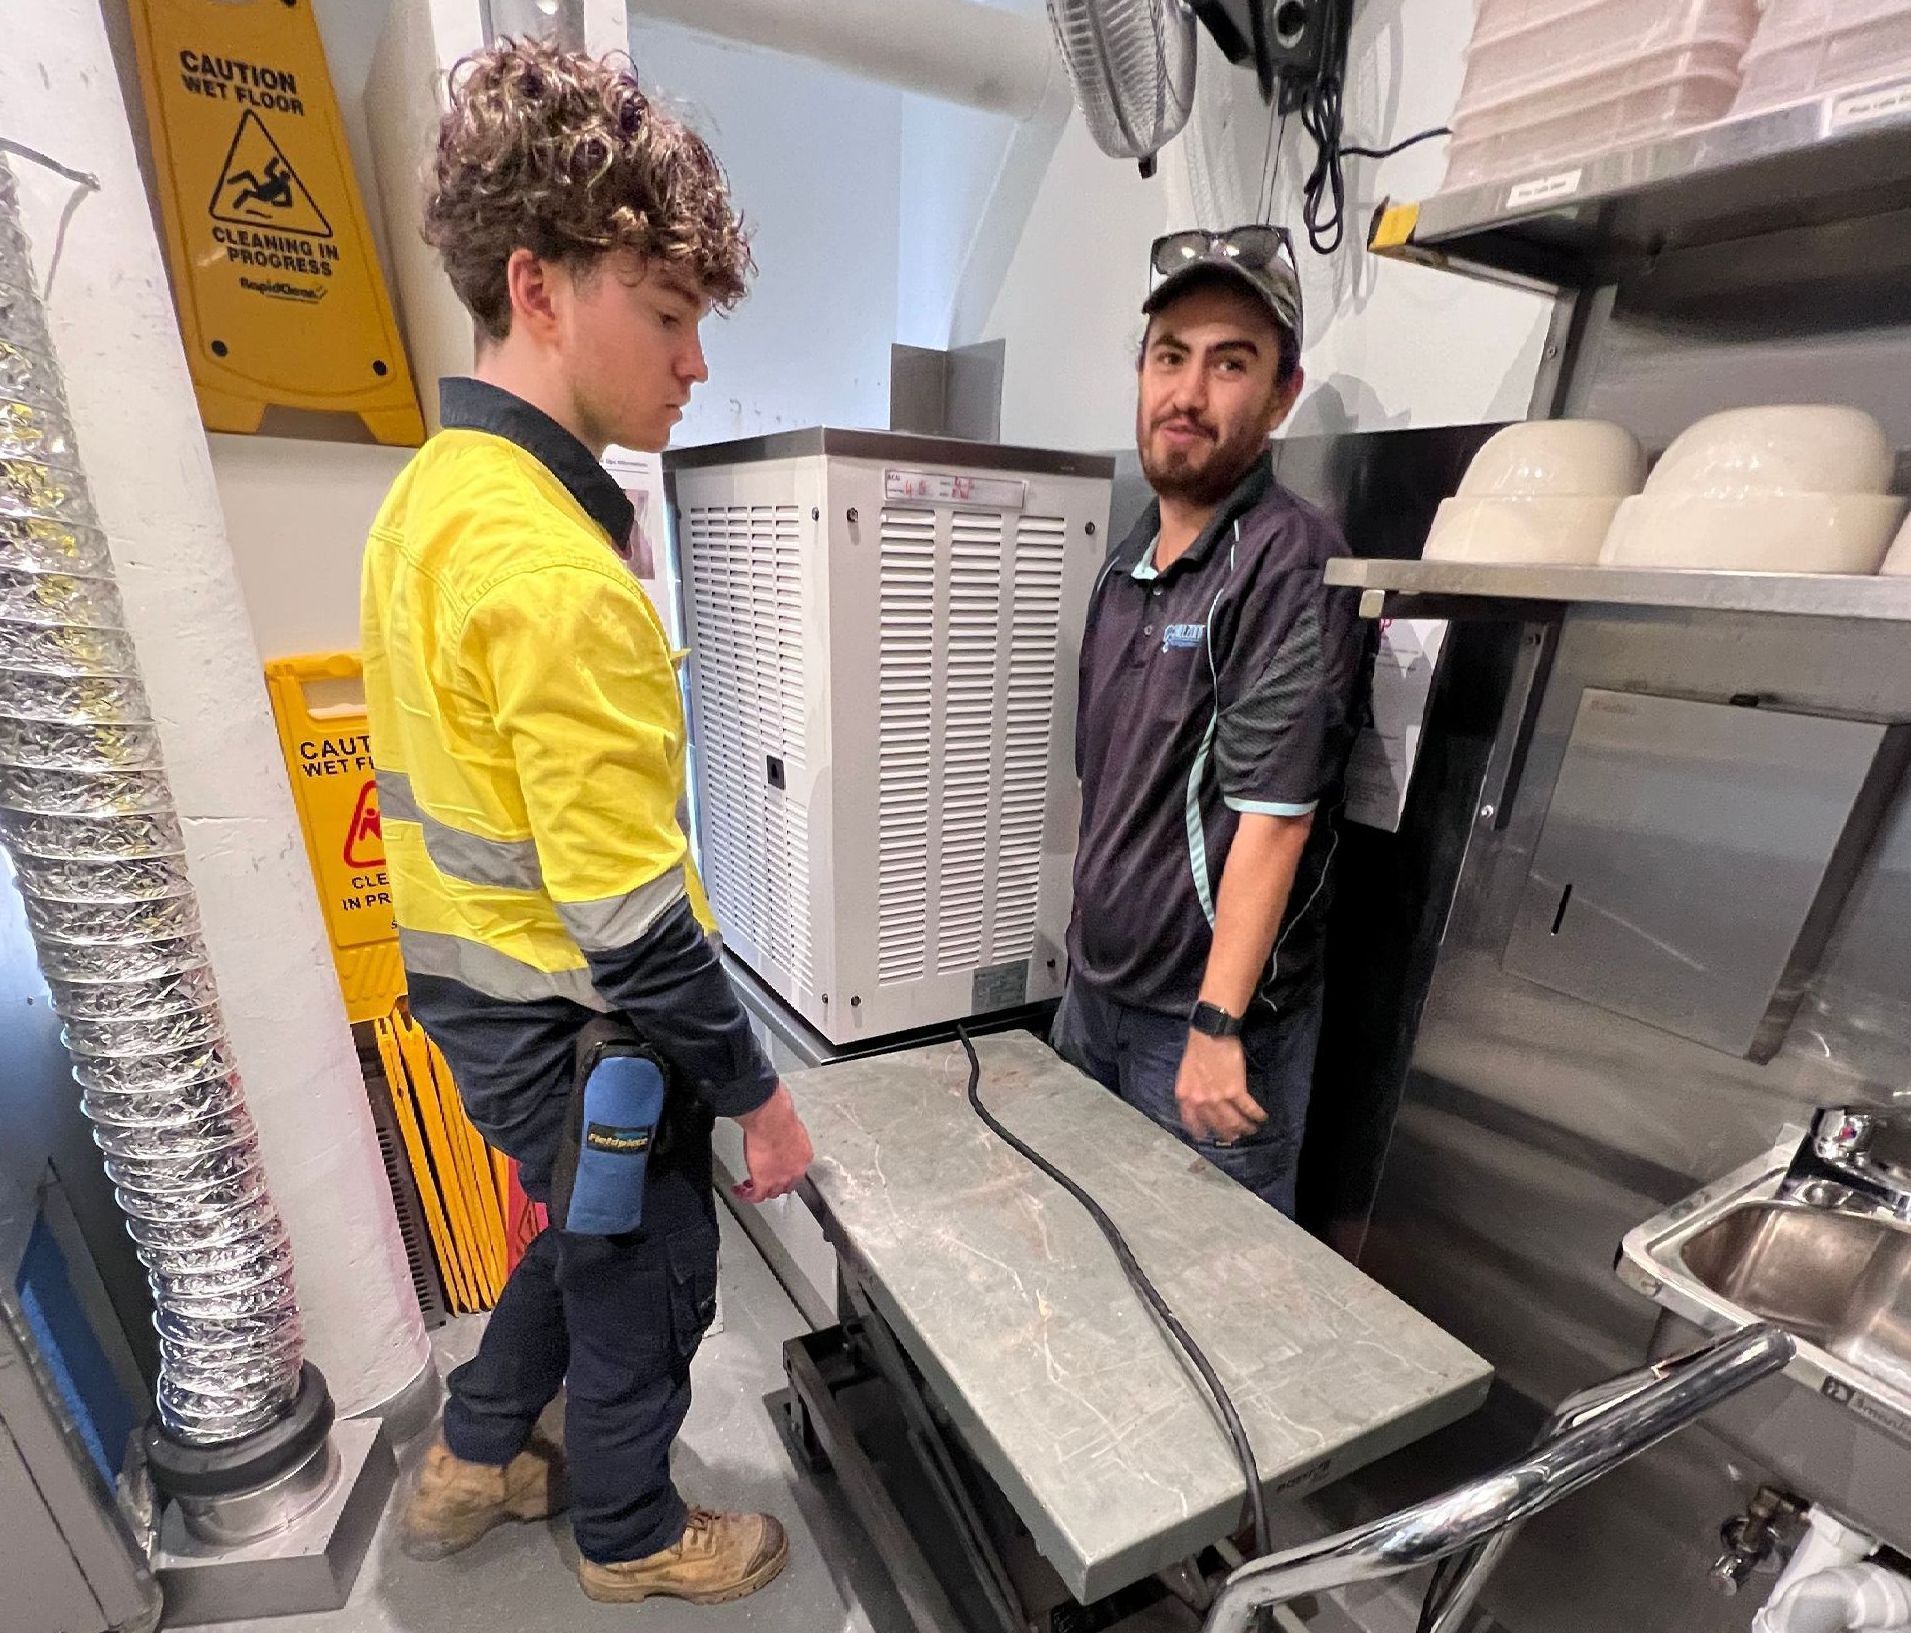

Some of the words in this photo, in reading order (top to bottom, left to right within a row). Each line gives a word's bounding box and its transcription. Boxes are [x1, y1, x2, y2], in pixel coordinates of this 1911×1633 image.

[180, 50, 296, 94] CAUTION
[181, 73, 225, 99] WET
[235, 85, 304, 116] FLOOR
[212, 226, 311, 256] CLEANING
[318, 243, 339, 260] IN
[227, 246, 331, 276] PROGRESS
[302, 759, 348, 777] WET
[342, 897, 361, 911] IN
